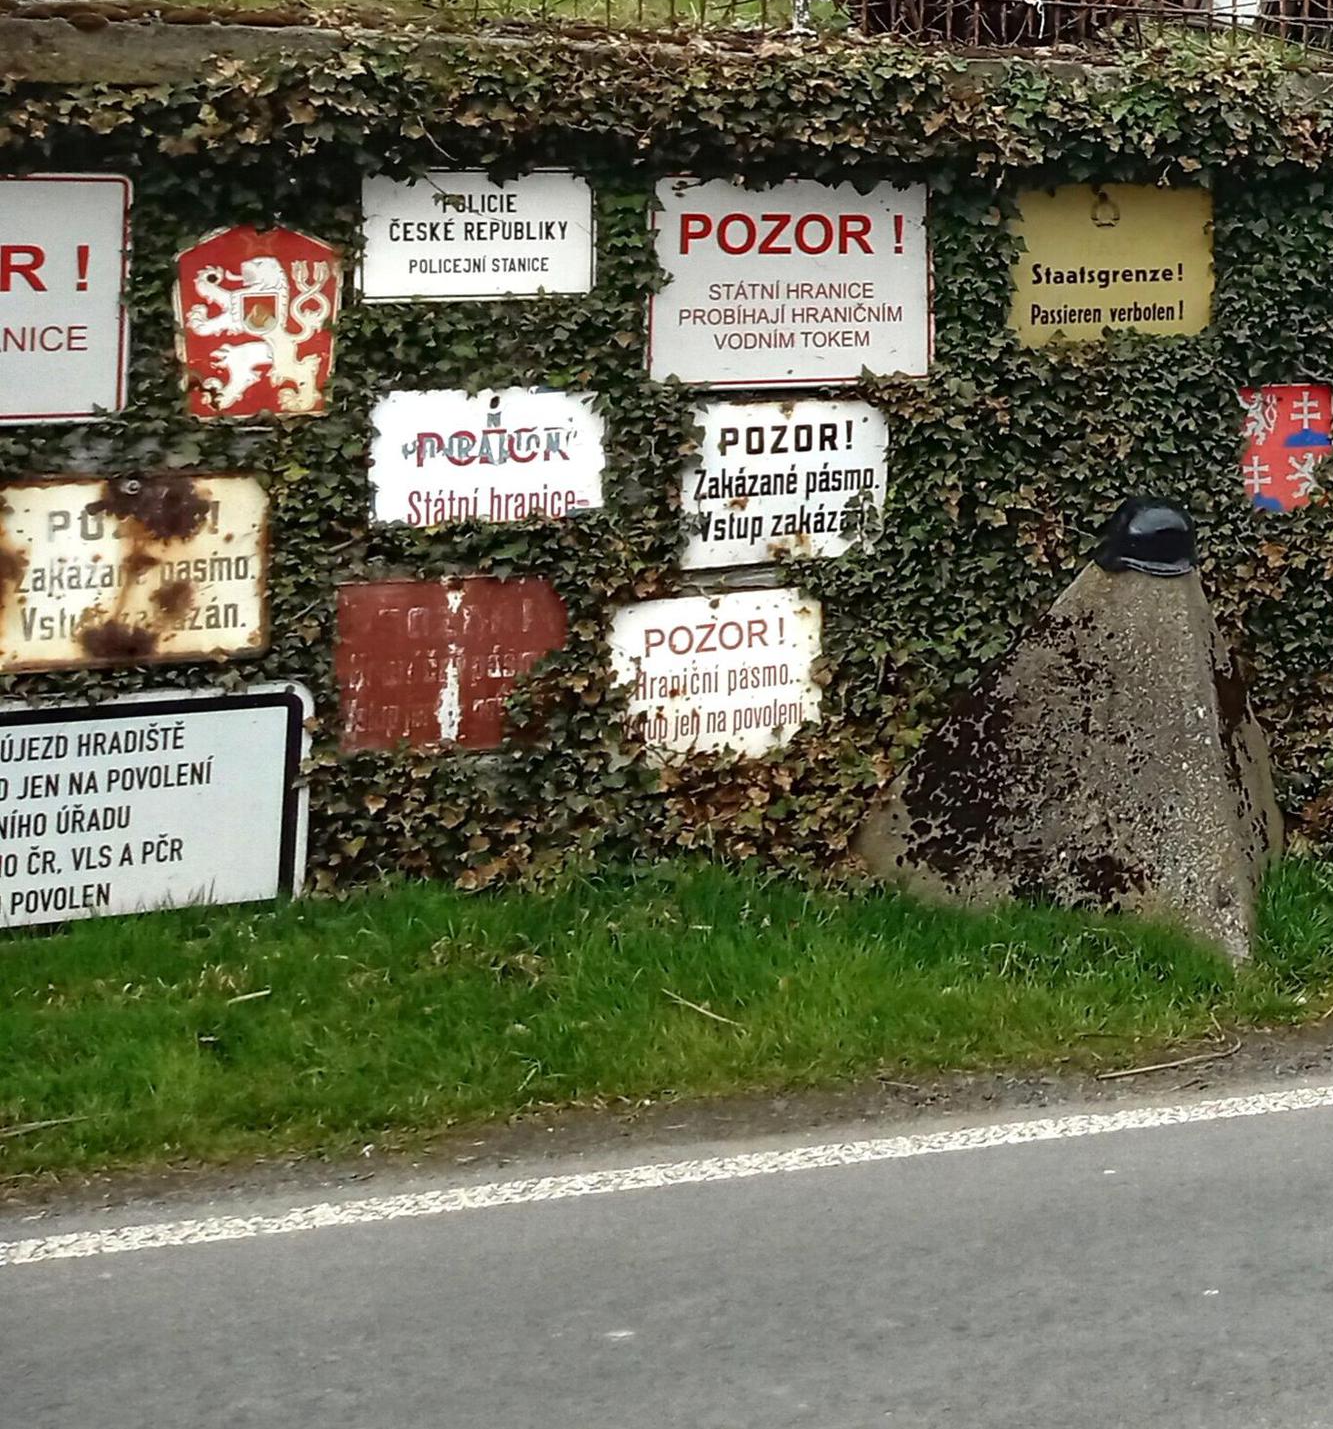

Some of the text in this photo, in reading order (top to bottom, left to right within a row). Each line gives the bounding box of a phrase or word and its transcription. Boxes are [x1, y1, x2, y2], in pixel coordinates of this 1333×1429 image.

[388, 218, 569, 242] ČESKÉ REPUBLIKY
[408, 255, 550, 274] POLICEJNÍ STANICE
[708, 280, 875, 301] STÁTNÍ HRANICE
[679, 302, 903, 326] PROBÍHAJÍ HRANIČNÍM
[1031, 303, 1102, 325] Passieren
[0, 325, 89, 352] NICE
[713, 328, 870, 350] VODNÍM TOKEM
[693, 461, 880, 501] Zakázané pásmo.
[407, 486, 479, 526] Státní
[701, 503, 862, 545] Vstup zakáza
[706, 710, 727, 734] na
[0, 721, 186, 763] ÚJEZD HRADIŠTĚ
[16, 773, 60, 800] JEN
[68, 771, 99, 796] NA
[106, 755, 215, 793] POVOLENÍ
[56, 804, 132, 835] ÚŘADU
[71, 844, 113, 872] VLS
[118, 842, 134, 867] A
[141, 833, 184, 865] PČR
[10, 883, 111, 915] POVOLEN
